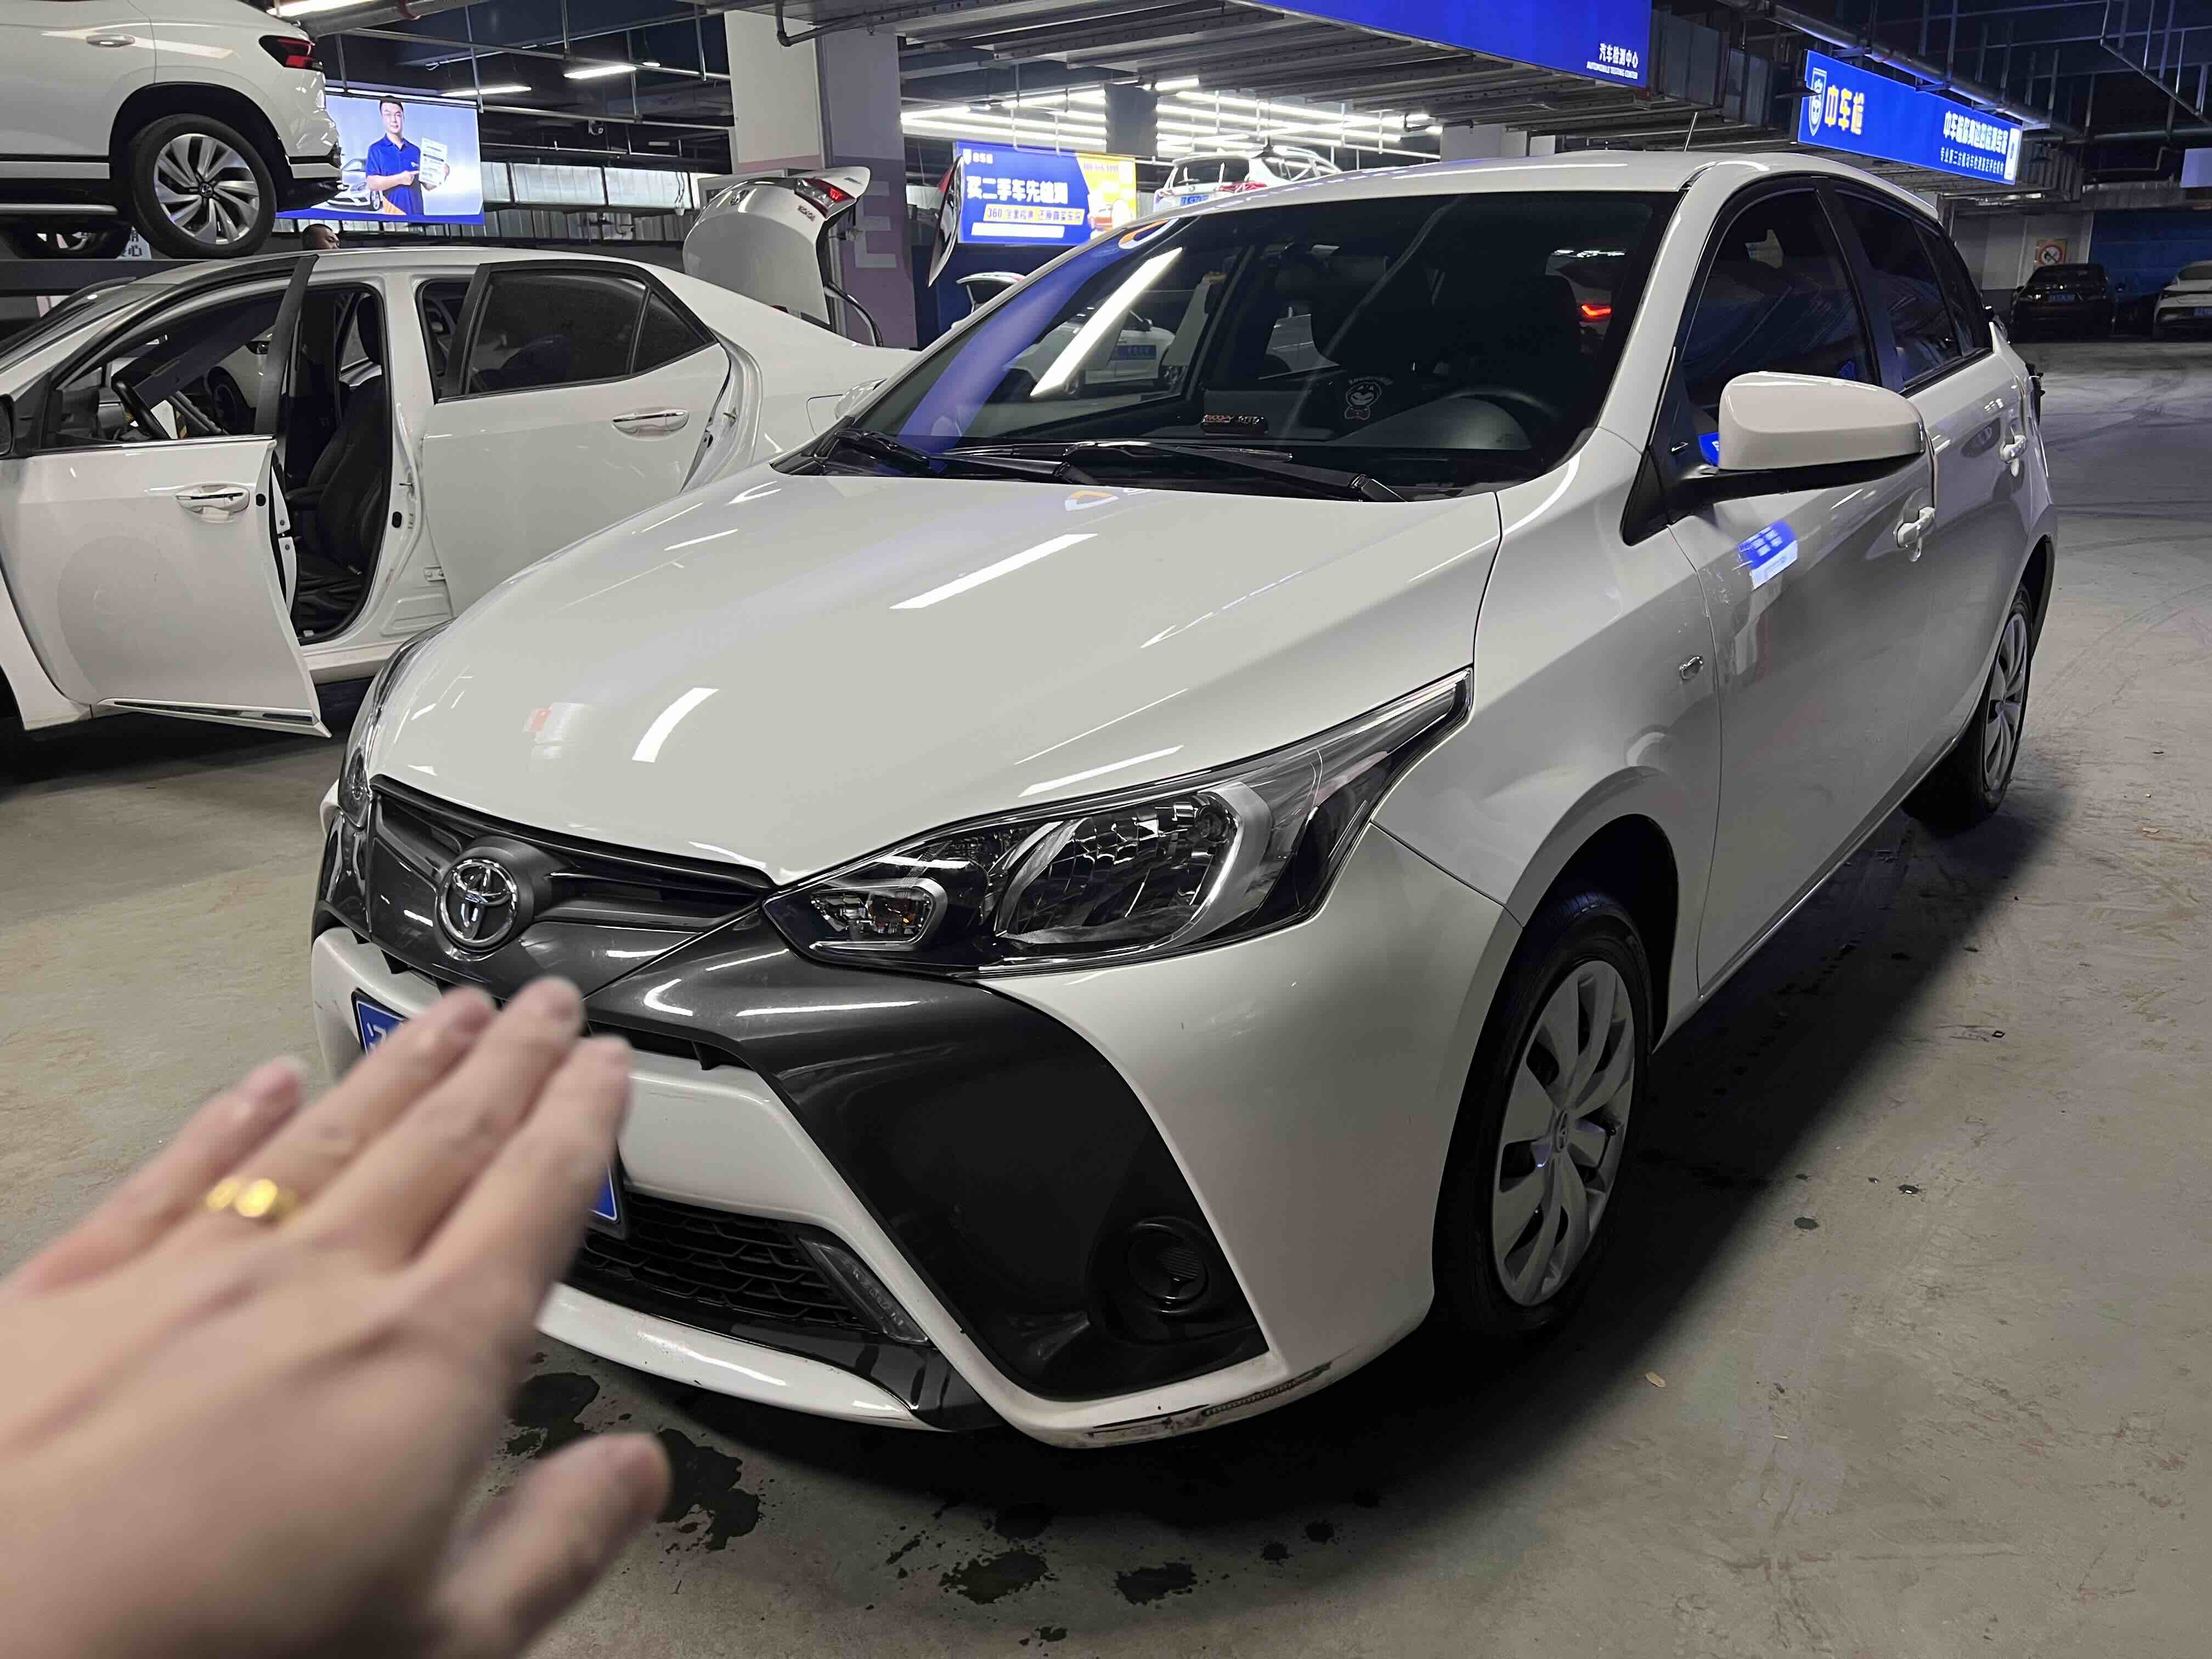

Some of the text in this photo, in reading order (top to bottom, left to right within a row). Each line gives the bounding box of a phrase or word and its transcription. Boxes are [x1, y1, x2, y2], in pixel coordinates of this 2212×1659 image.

[1599, 43, 1639, 68] 汽车检测中心
[988, 207, 1002, 218] 360
